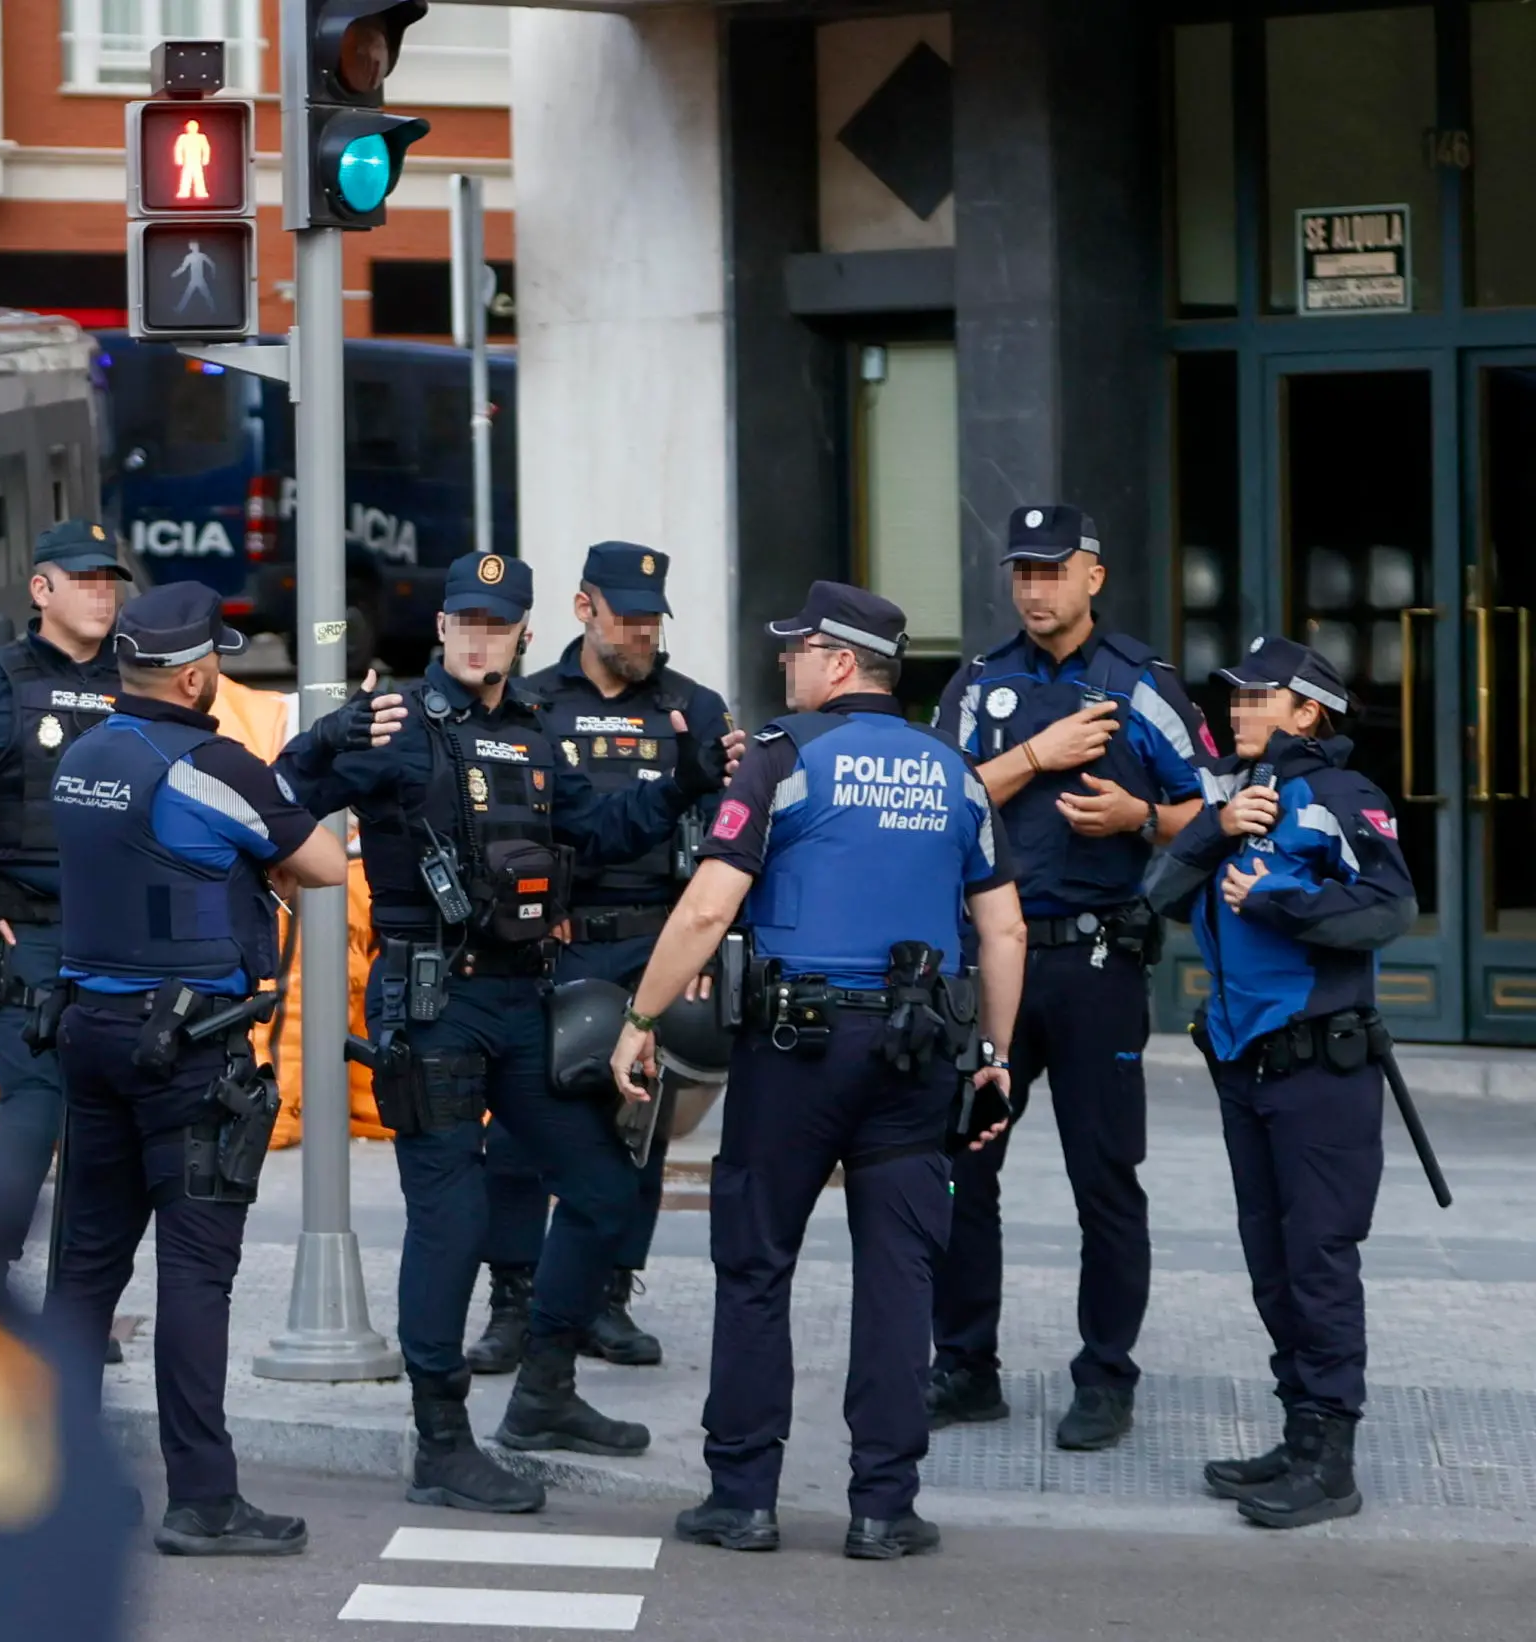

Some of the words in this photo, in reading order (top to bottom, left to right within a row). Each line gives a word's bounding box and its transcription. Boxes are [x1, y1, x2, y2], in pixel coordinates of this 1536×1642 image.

[1305, 217, 1329, 251] SE
[1331, 213, 1403, 253] ALQUILA
[131, 520, 235, 557] ICIA
[52, 698, 116, 712] NACIONAL
[575, 723, 644, 734] NACIONAL
[834, 751, 947, 787] POLICÍA
[832, 783, 949, 811] MUNICIPAL
[878, 811, 948, 831] Madrid
